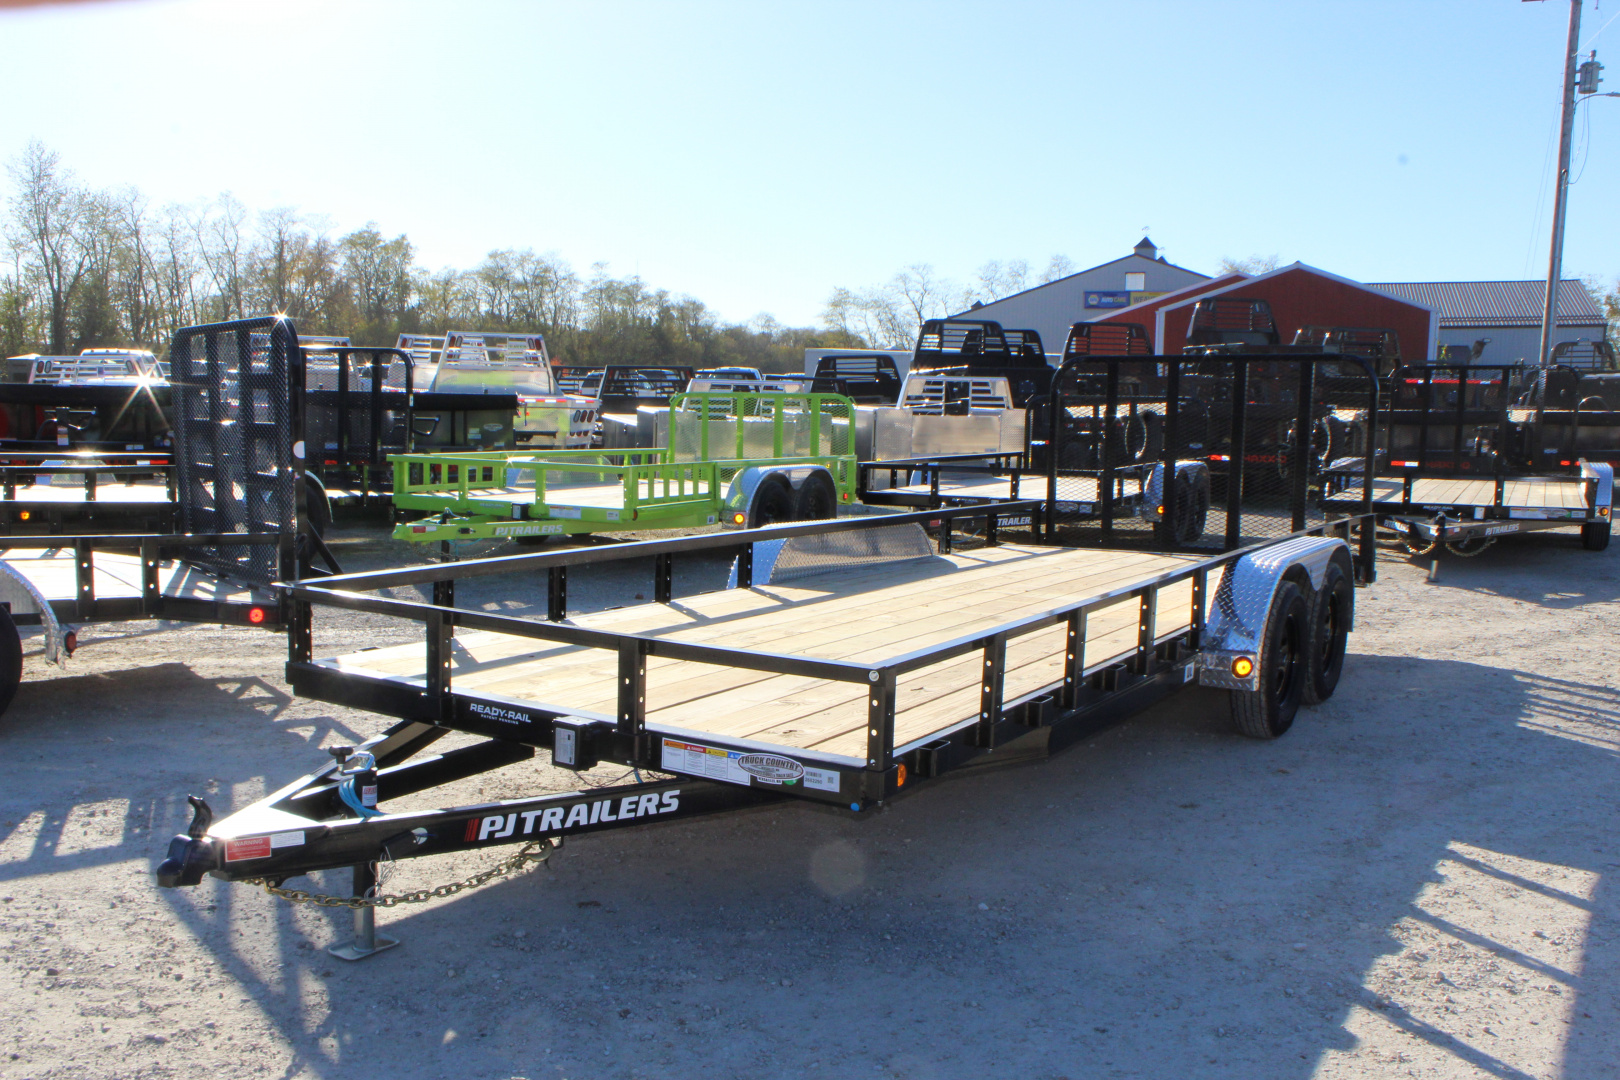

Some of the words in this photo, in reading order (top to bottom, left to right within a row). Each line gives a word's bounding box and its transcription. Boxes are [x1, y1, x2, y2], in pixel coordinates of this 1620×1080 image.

[741, 756, 765, 765] TRUCK
[765, 757, 800, 772] COUNTRY
[233, 838, 264, 847] WARNING
